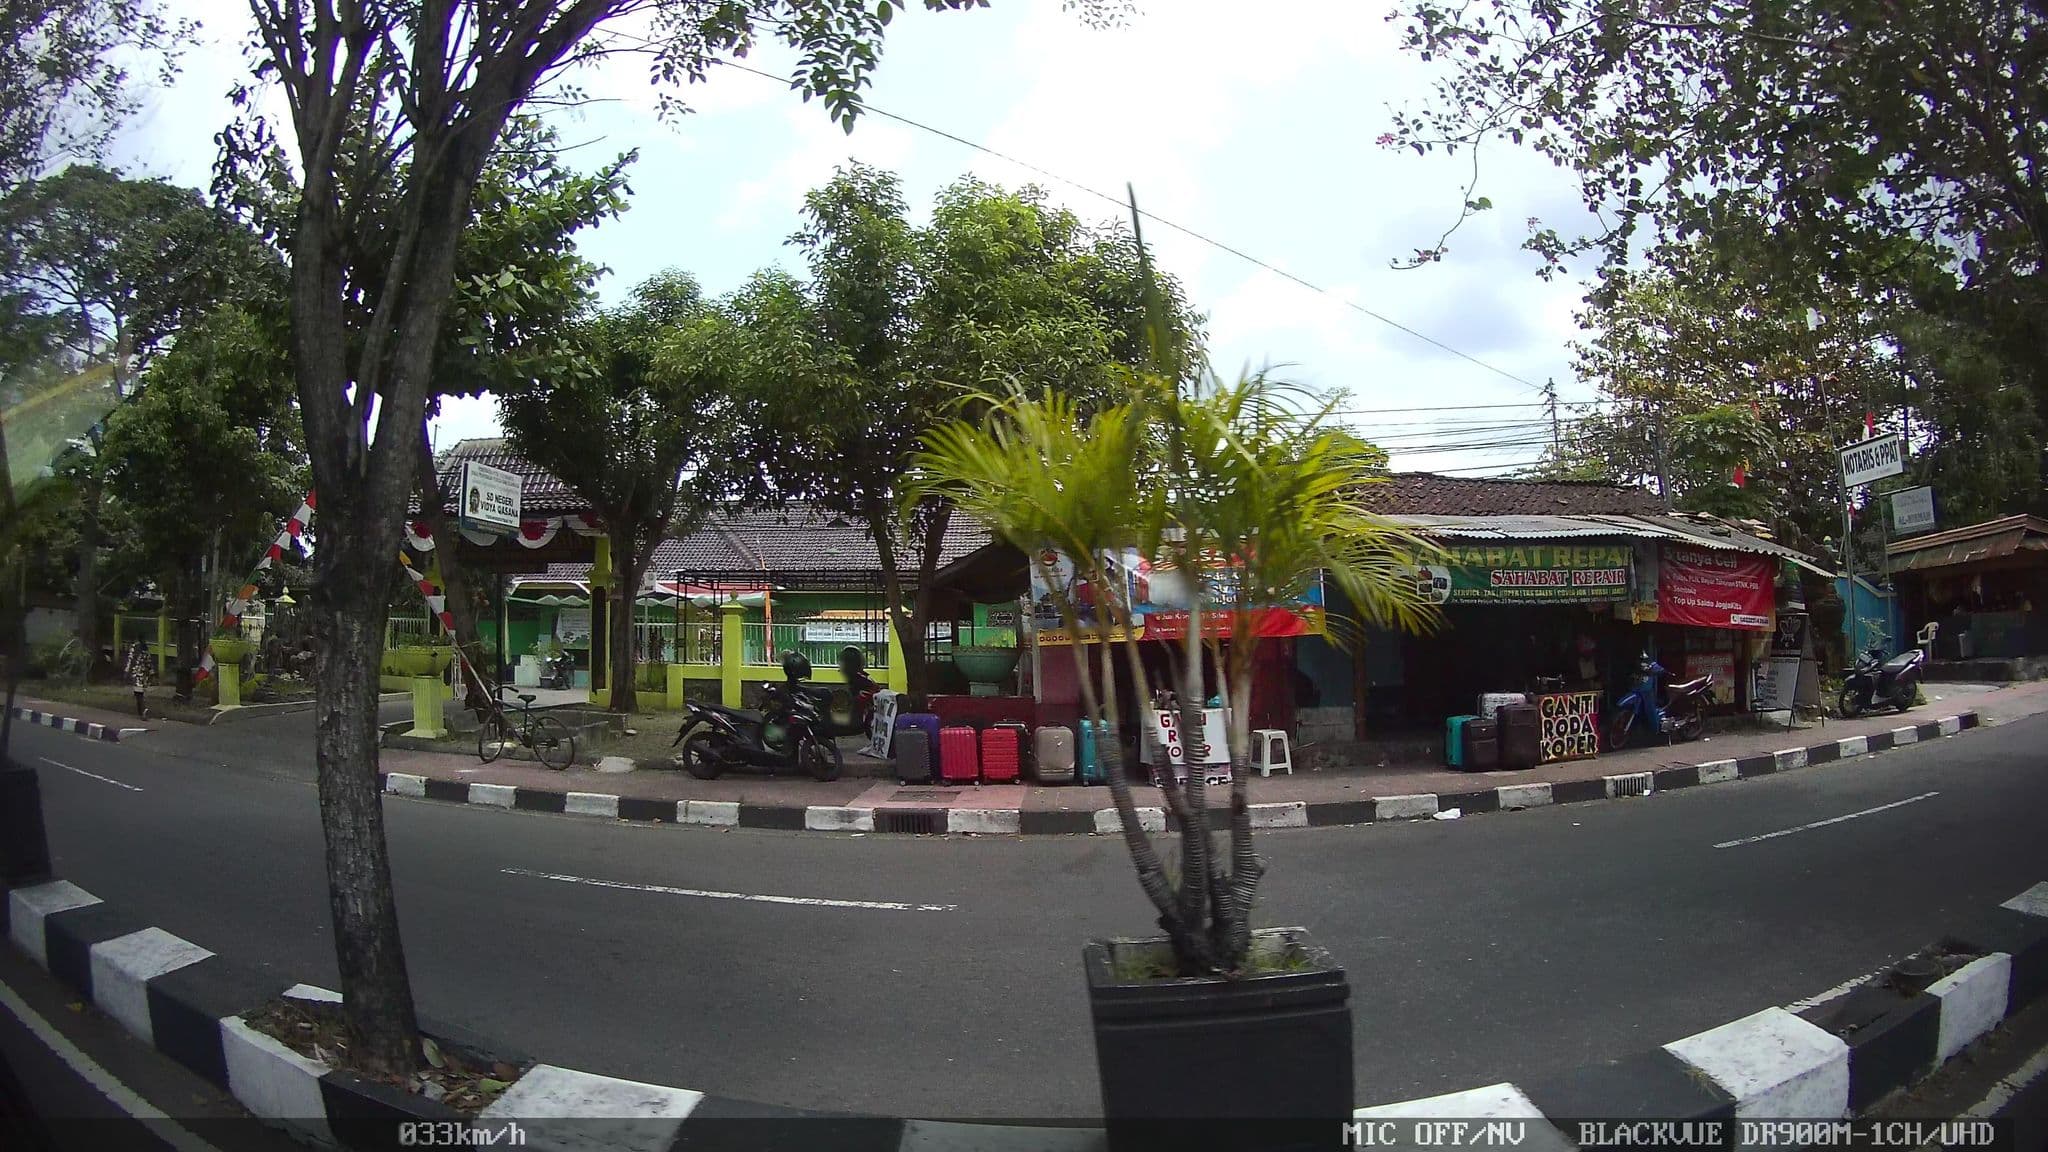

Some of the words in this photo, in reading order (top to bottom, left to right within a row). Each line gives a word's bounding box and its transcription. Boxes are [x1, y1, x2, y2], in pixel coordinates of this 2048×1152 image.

[1844, 448, 1875, 476] NOTARIS
[1875, 450, 1881, 467] &
[1880, 440, 1899, 466] PPAT
[481, 501, 496, 512] VIDYA
[486, 492, 494, 502] SD
[495, 494, 514, 507] NEGERI
[1407, 546, 1545, 567] AHABAT
[1491, 570, 1569, 587] SAHABAT
[1572, 569, 1626, 586] REPAIR
[1673, 596, 1686, 606] Top
[1687, 597, 1696, 607] Up
[1697, 598, 1714, 608] Saldo
[1541, 693, 1599, 718] GANTI
[1542, 714, 1595, 739] RODA
[1540, 735, 1599, 761] KOPER
